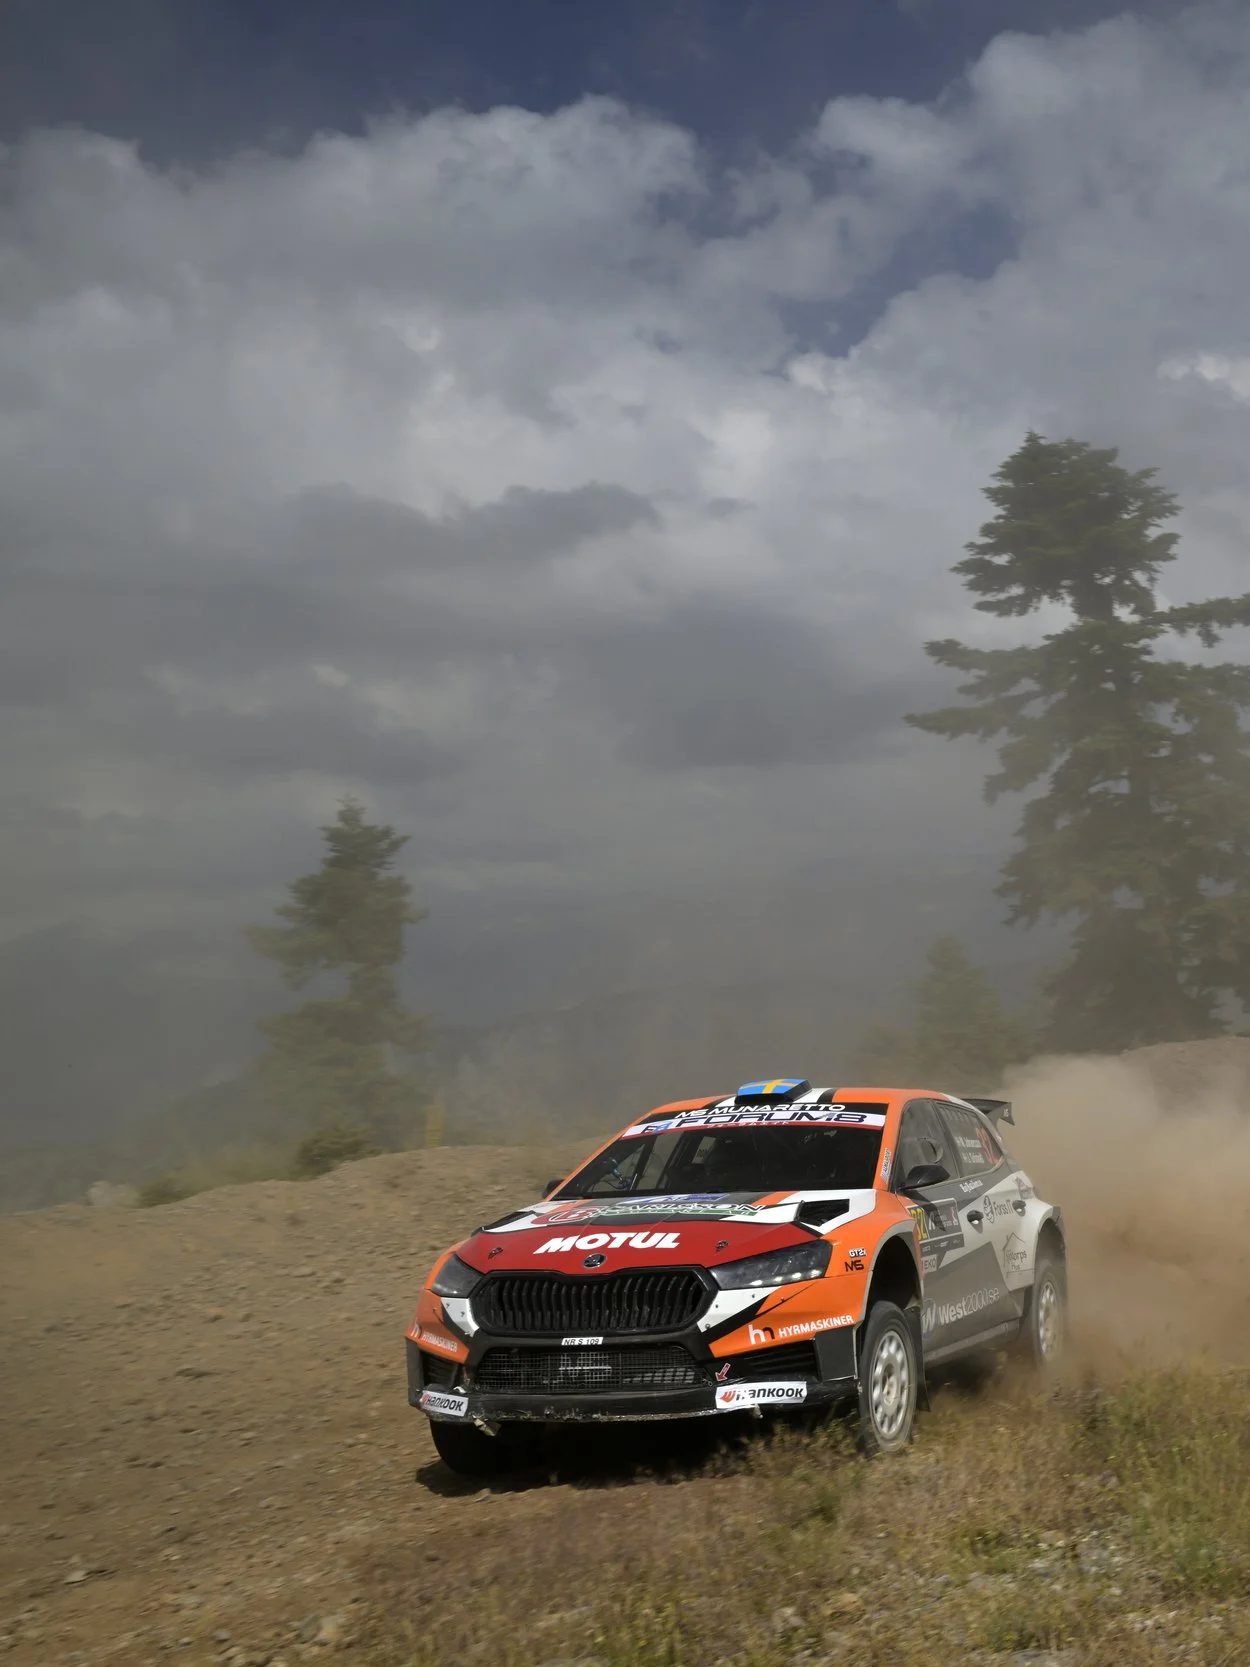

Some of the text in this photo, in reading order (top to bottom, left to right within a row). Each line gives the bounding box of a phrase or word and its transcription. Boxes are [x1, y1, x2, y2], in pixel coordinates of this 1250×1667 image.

[674, 1104, 846, 1119] MS MUNARETTO
[677, 1112, 868, 1127] FORUM8
[533, 1232, 681, 1254] MOTUL
[778, 1315, 854, 1338] HYRMASKINER
